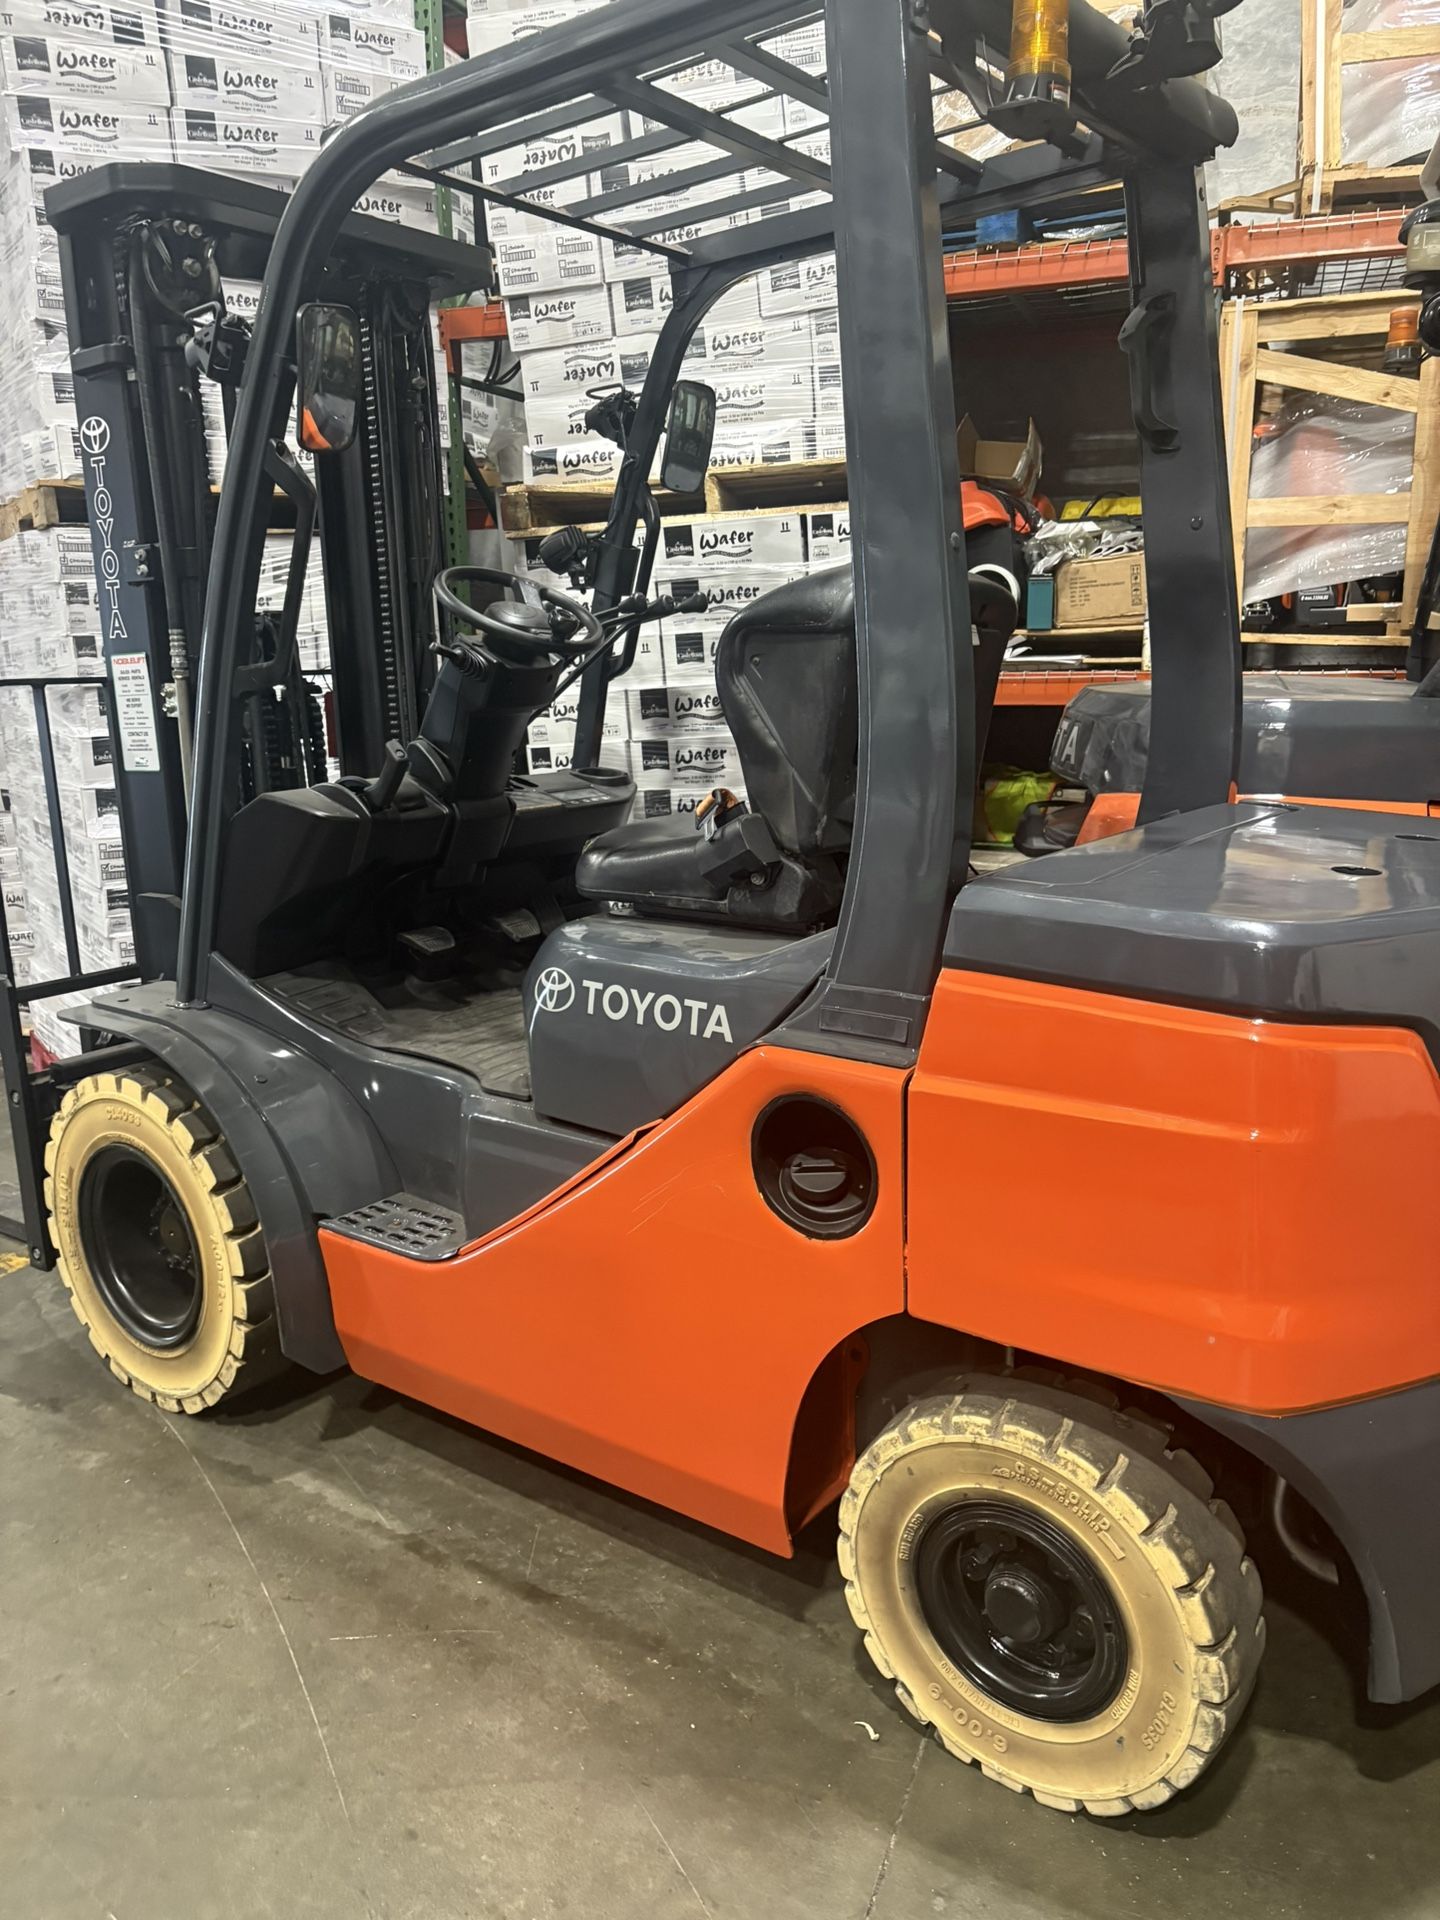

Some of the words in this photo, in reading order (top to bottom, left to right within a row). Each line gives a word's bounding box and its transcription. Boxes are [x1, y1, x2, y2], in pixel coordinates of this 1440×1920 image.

[44, 11, 104, 30] Wafer
[355, 30, 395, 46] Wafer
[57, 51, 116, 69] Wafer
[224, 70, 278, 89] Wafer
[60, 110, 119, 128] Wafer
[224, 124, 278, 142] Wafer
[524, 143, 576, 165] Wafer
[354, 197, 402, 213] Wafer
[535, 301, 576, 317] Wafer
[712, 331, 765, 351] Wafer
[564, 360, 614, 381] Wafer
[563, 450, 615, 469] Wafer
[90, 456, 128, 639] TOYOTA
[700, 530, 754, 550] Wafer
[707, 586, 759, 604] Wafer
[675, 748, 727, 764] Wafer
[582, 979, 733, 1043] TOYOTA
[1010, 1471, 1071, 1507] PERFORMANCE
[1015, 1461, 1111, 1531] GS-SOLID
[903, 1513, 925, 1542] GUARD
[899, 1542, 911, 1560] RIM
[928, 1682, 1009, 1754] 6.00-9
[1141, 1690, 1177, 1752] CL403S
